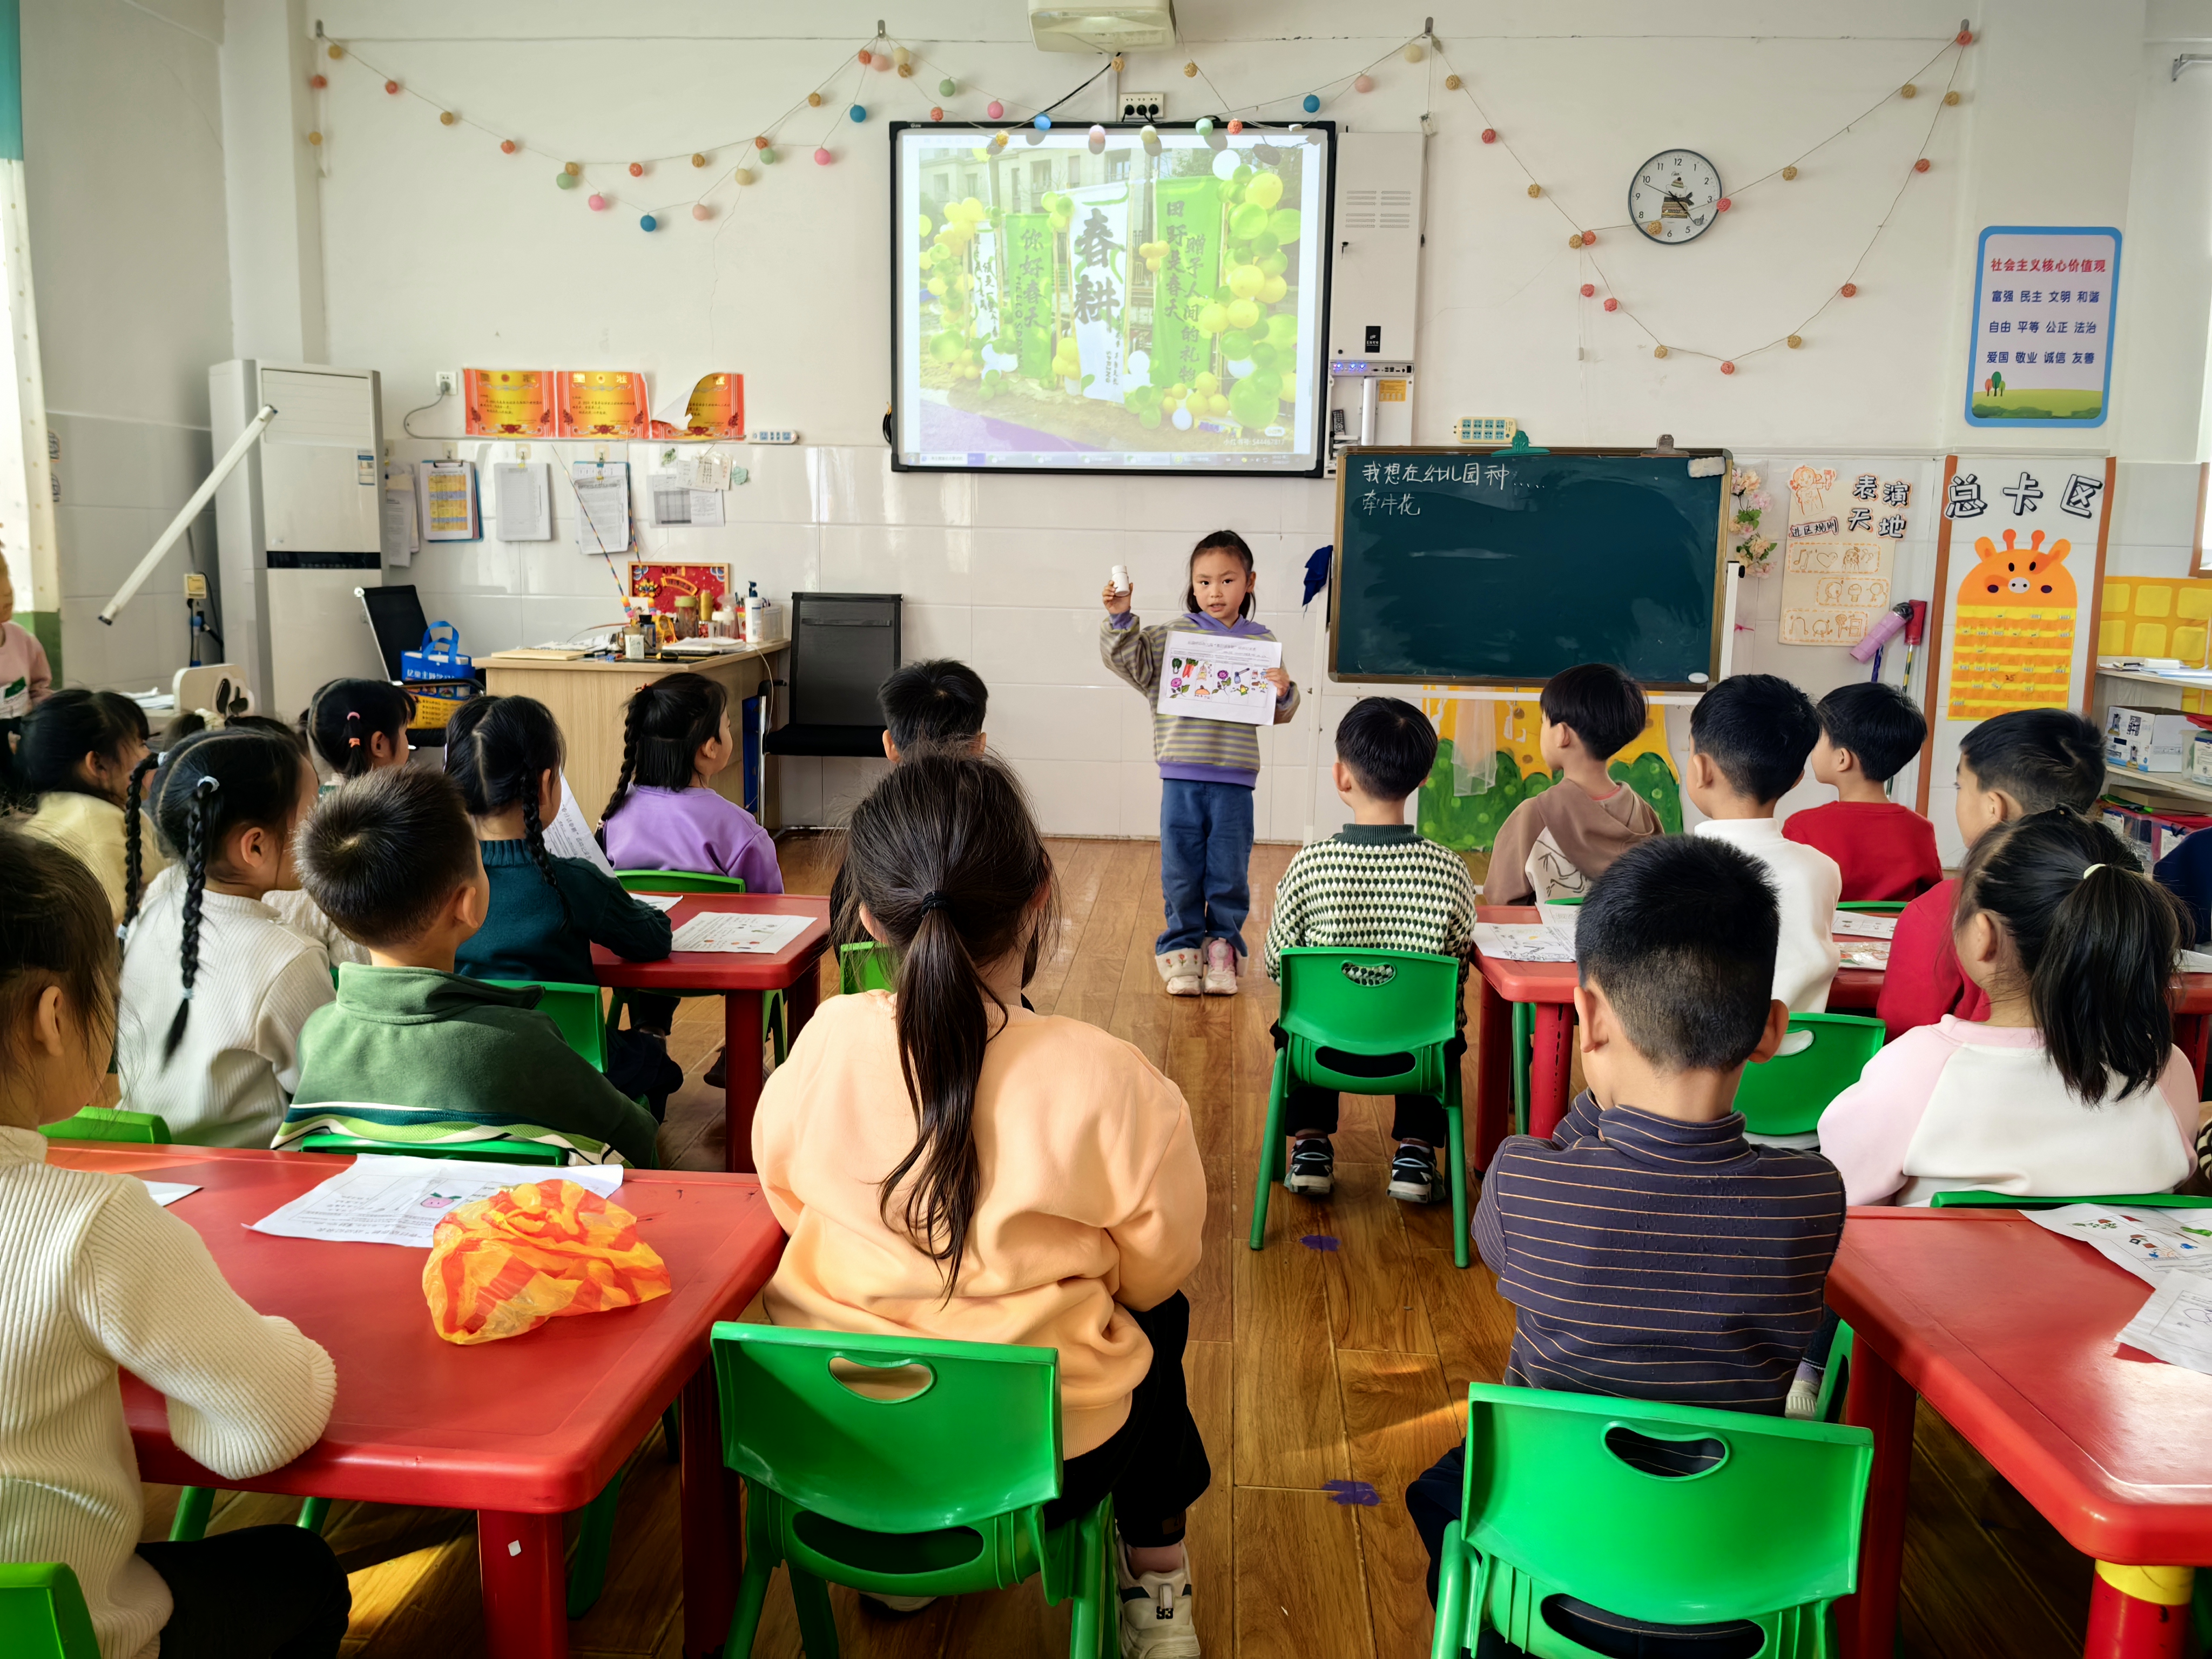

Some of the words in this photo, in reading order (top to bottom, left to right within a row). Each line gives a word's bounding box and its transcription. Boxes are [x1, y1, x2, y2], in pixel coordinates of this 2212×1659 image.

[1657, 163, 1664, 171] 11
[1643, 176, 1650, 184] 10
[1074, 208, 1125, 333] 春耕
[1991, 258, 2106, 272] 社会主义核心价值观
[1020, 228, 1047, 329] 你好春天
[1992, 290, 2013, 302] 富强
[2020, 291, 2042, 302] 民主
[2048, 291, 2071, 303] 文明
[2076, 291, 2100, 303] 和谐
[1989, 321, 2011, 333] 自由
[2018, 321, 2040, 333] 平等
[2046, 321, 2068, 333] 公正
[2074, 321, 2096, 334] 法治
[1986, 352, 2008, 363] 爱国
[2015, 352, 2037, 363] 敬业
[2044, 352, 2066, 364] 诚信
[2072, 352, 2094, 364] 友善
[1852, 475, 1910, 506] 表演
[1945, 472, 2103, 518] 总卡区
[1848, 508, 1906, 538] 天地
